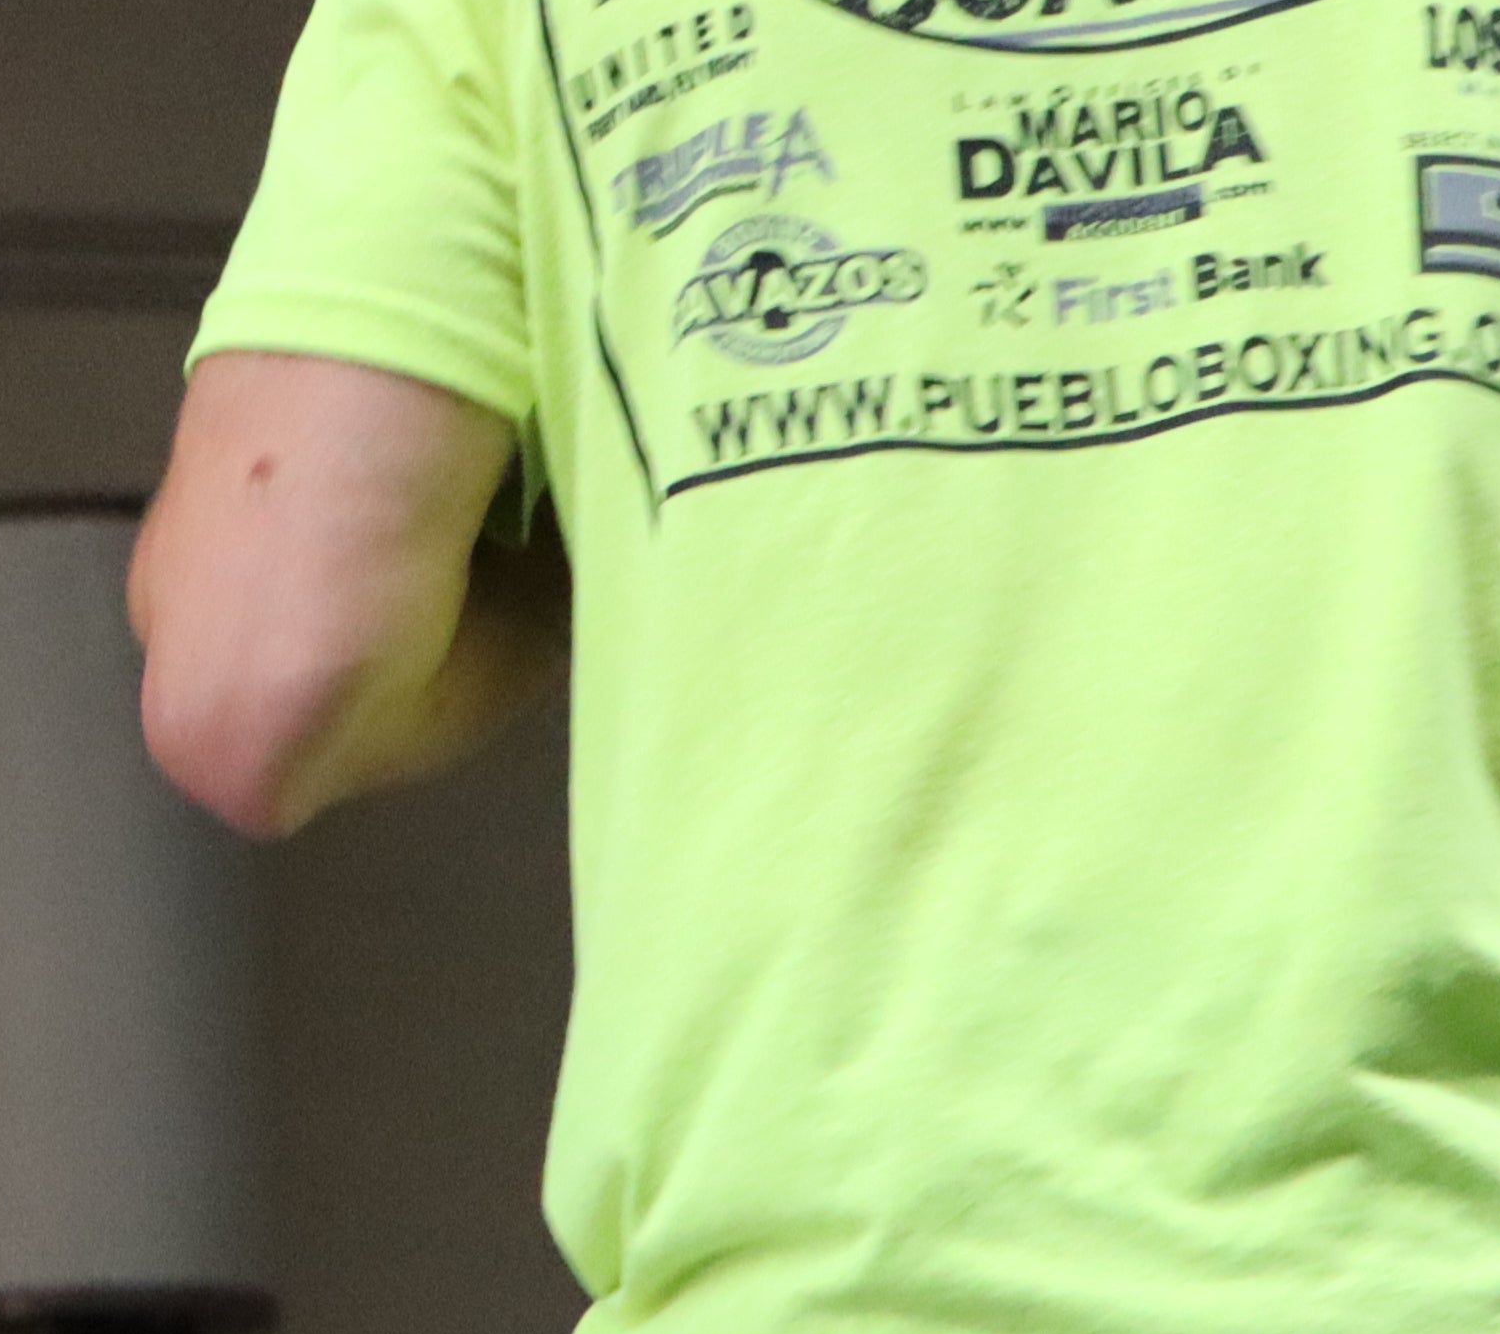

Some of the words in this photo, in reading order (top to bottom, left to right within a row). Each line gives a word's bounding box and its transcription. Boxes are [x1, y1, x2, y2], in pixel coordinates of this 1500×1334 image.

[568, 1, 756, 113] UNITED
[956, 103, 1267, 200] DAVILA
[1017, 89, 1211, 150] MARIO
[1052, 267, 1177, 326] First
[1193, 242, 1330, 301] Bank
